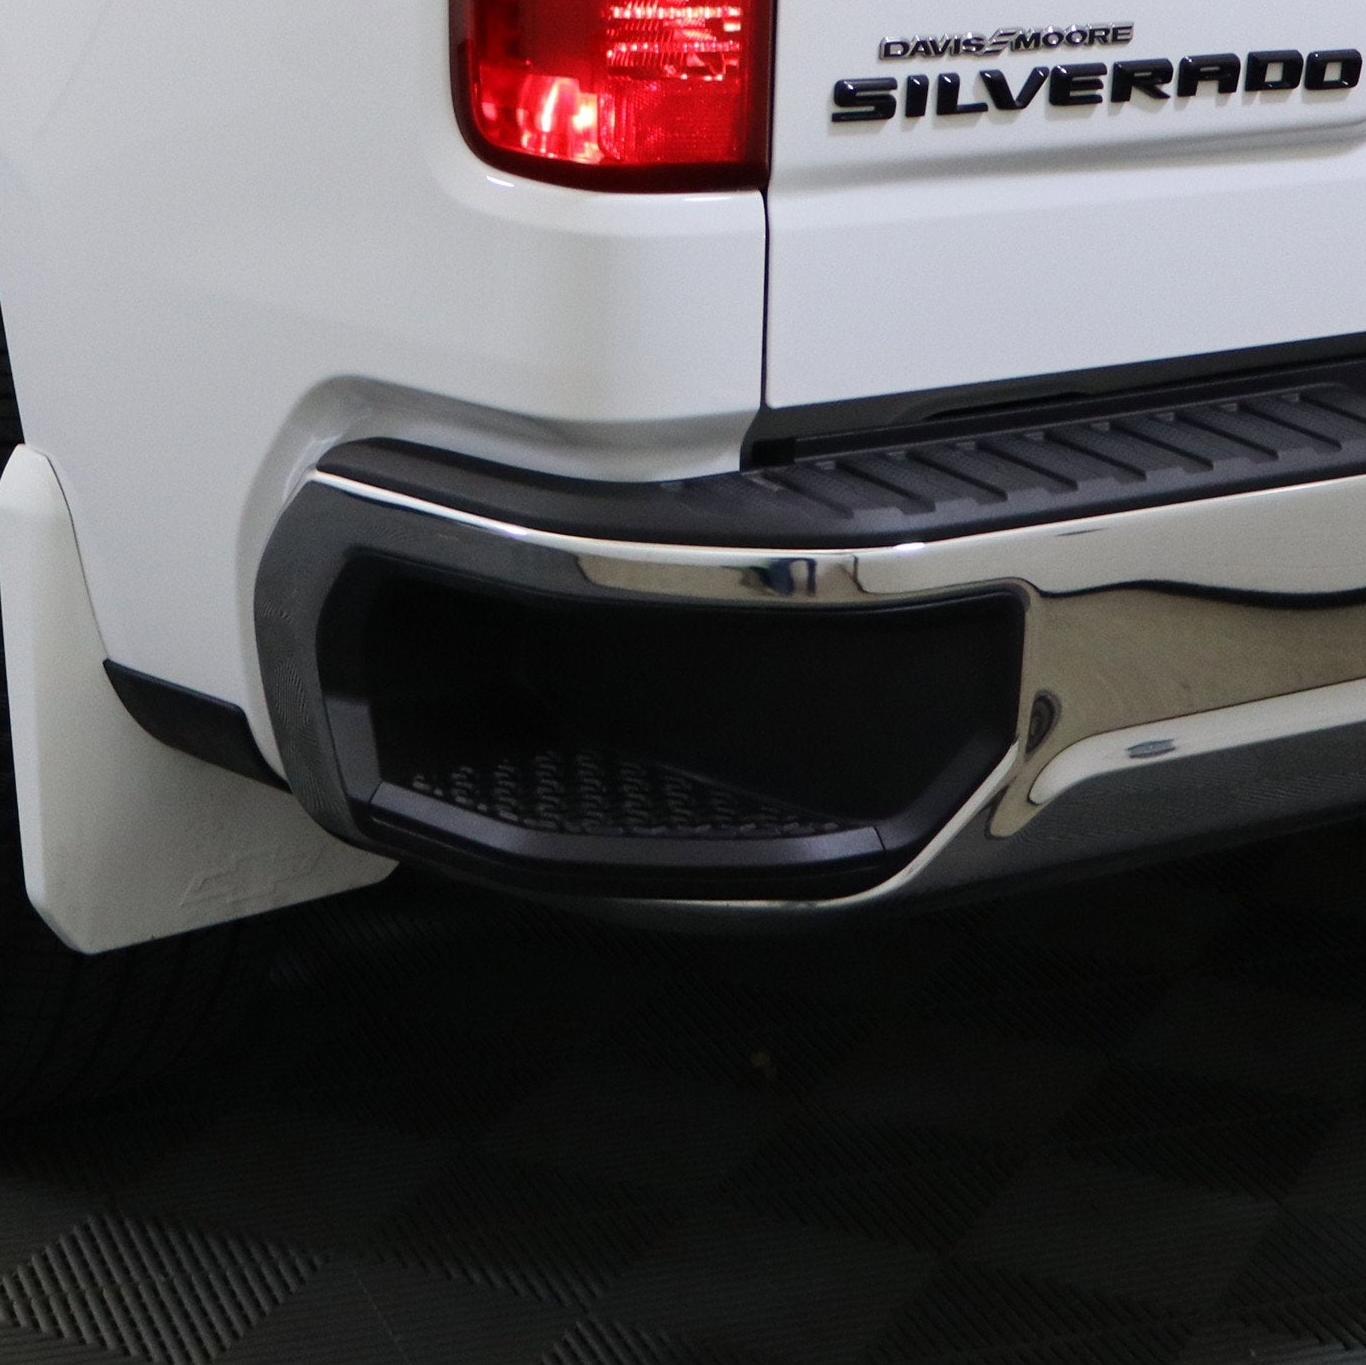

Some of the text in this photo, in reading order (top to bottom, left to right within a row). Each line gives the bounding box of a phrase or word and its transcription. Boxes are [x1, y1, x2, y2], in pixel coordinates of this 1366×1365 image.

[879, 21, 1134, 60] DAVIS MOORE
[830, 47, 1363, 123] SILVERADO
